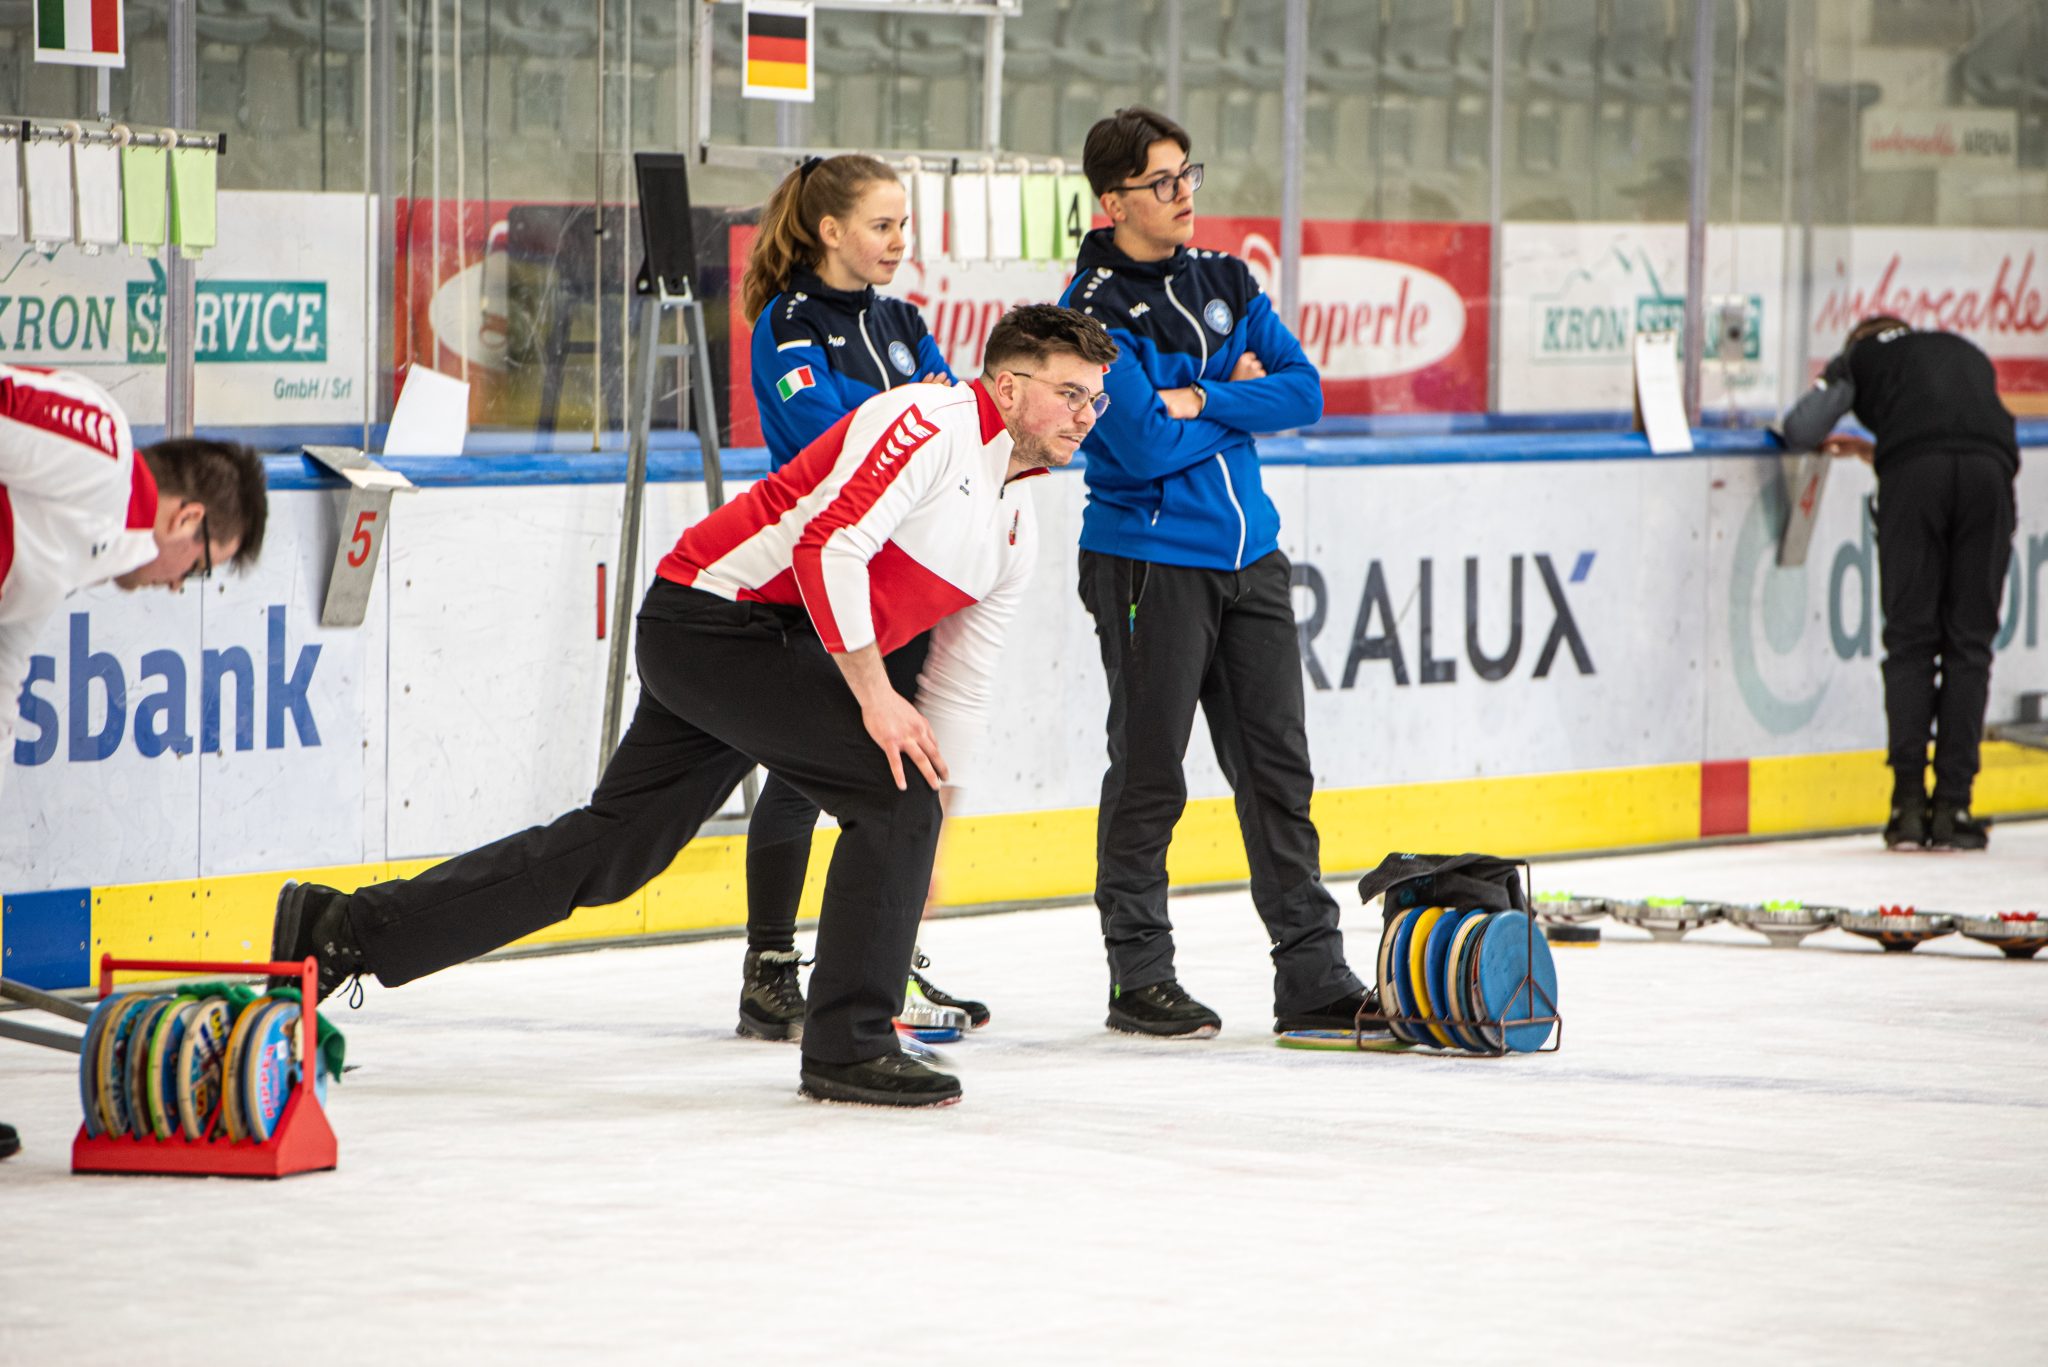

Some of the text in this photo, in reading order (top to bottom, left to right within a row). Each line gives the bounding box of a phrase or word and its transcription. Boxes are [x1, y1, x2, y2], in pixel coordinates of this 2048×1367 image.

[1067, 192, 1082, 248] 4
[1299, 276, 1428, 367] pperle
[1542, 306, 1628, 352] KRON
[274, 377, 319, 398] GmbH
[347, 511, 377, 567] 5
